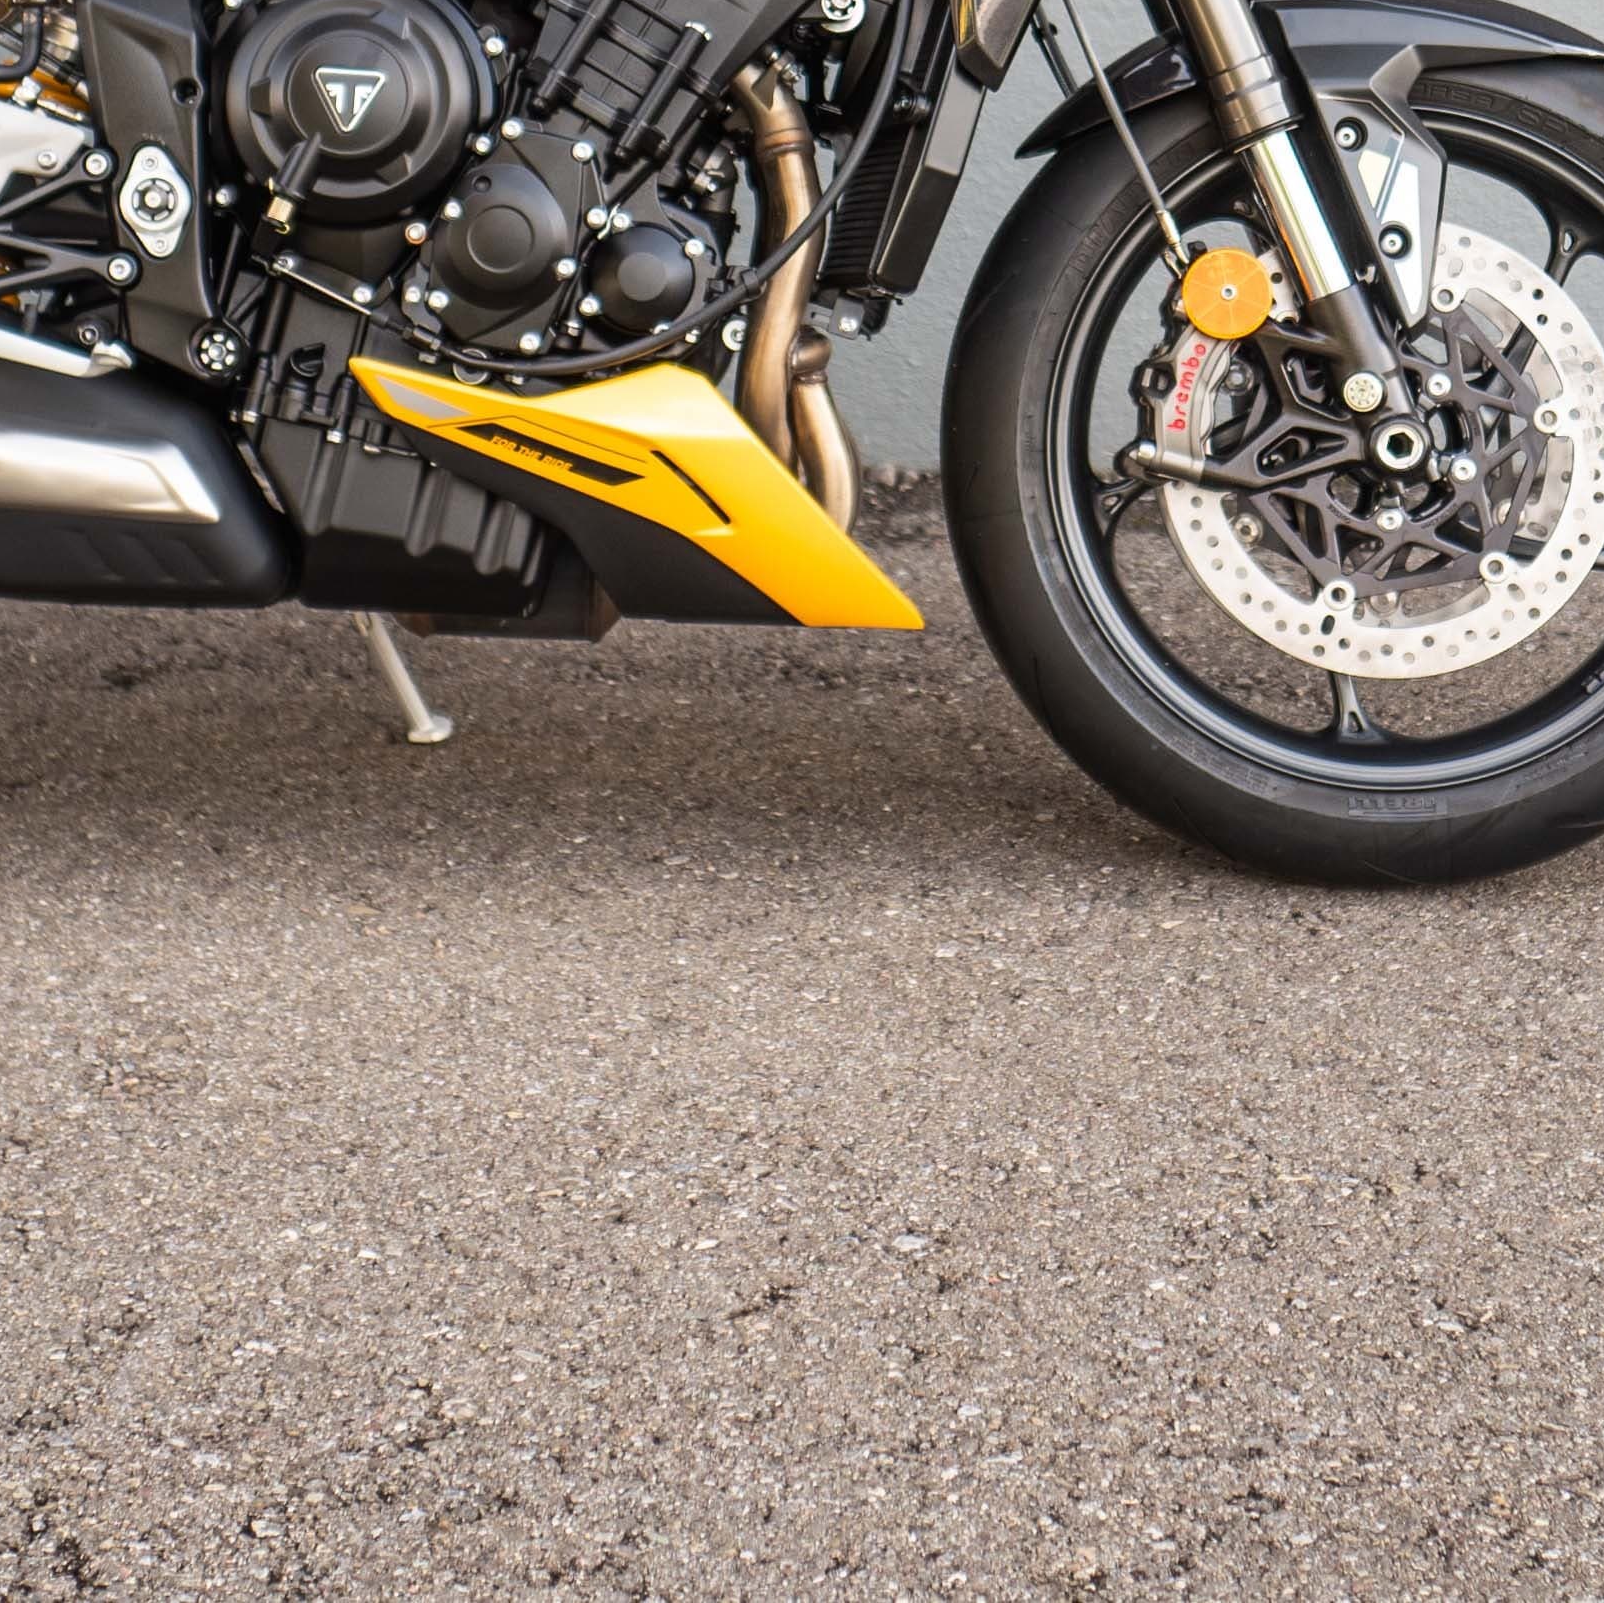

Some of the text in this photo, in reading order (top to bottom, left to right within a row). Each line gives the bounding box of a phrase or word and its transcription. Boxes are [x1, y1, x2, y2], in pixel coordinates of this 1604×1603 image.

[1167, 343, 1207, 431] brembo
[491, 435, 574, 472] FOR THE RIDE
